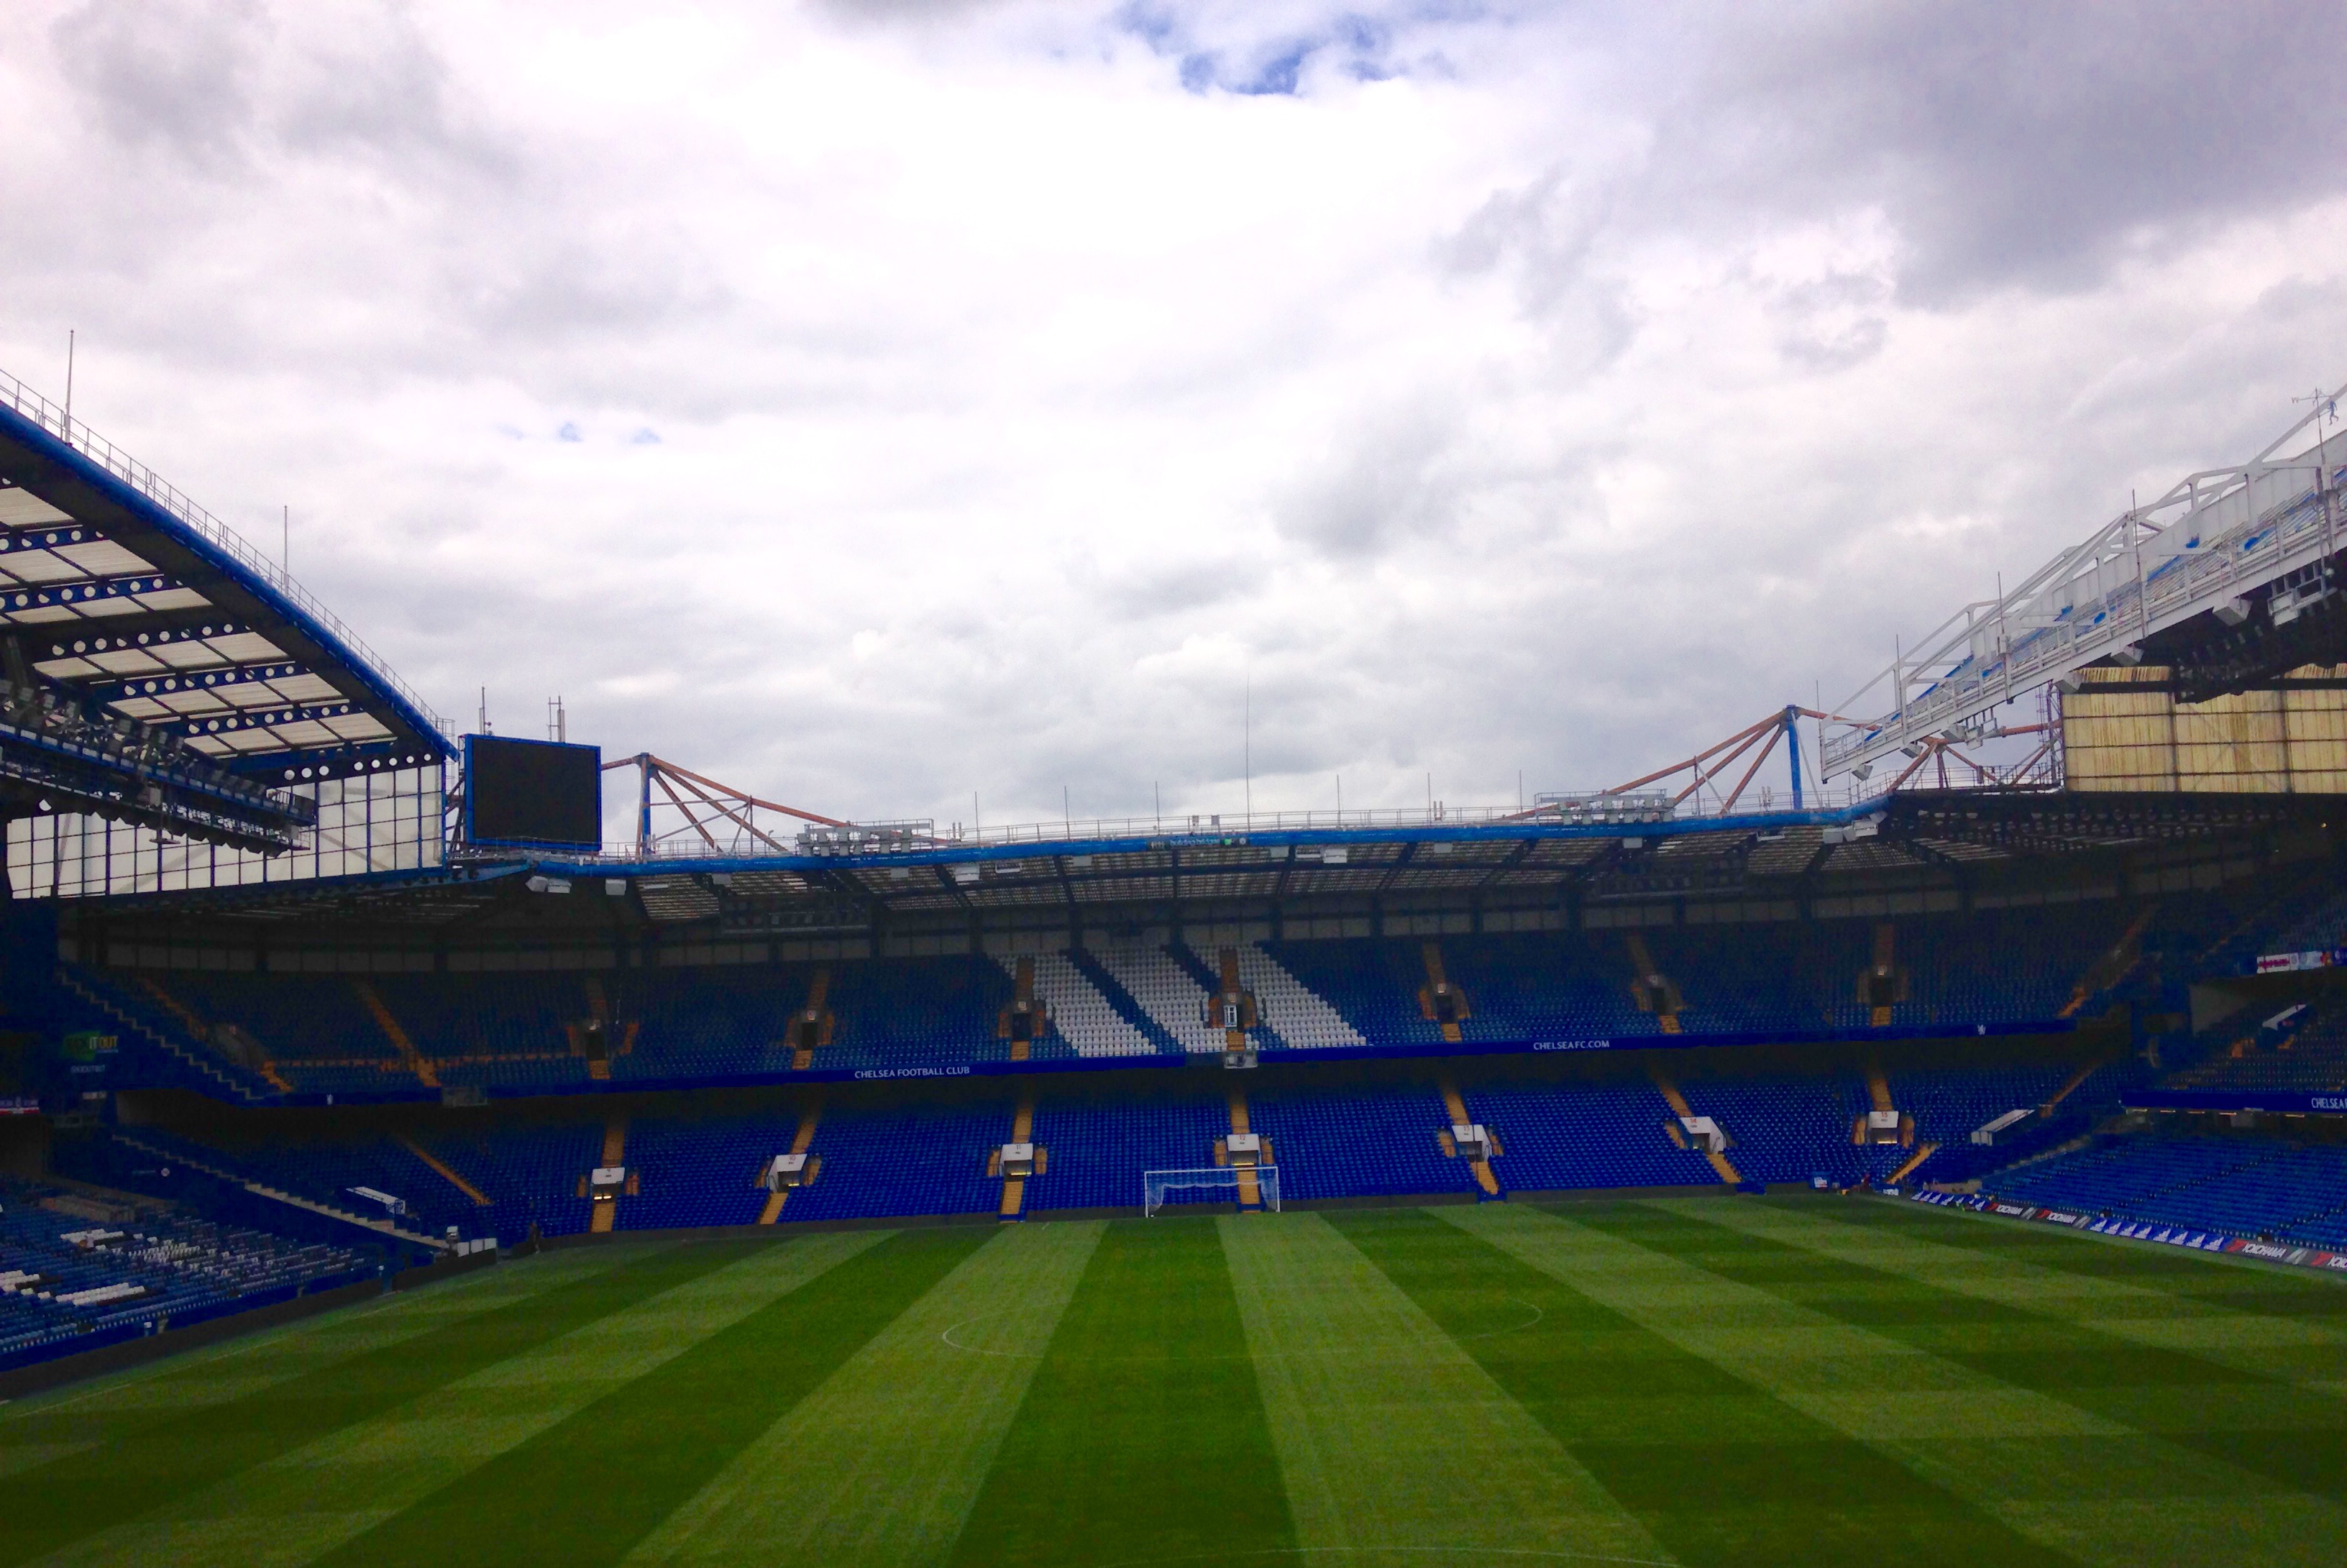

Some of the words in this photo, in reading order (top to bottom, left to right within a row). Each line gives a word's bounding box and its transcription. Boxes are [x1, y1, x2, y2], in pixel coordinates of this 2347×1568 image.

[1533, 1040, 1610, 1050] CHELSEAFC.COM
[854, 1069, 895, 1079] CHELSEA
[897, 1067, 945, 1077] FOOTBALL
[946, 1066, 970, 1076] CLUB
[2311, 1097, 2345, 1109] CHELSEA
[2242, 1242, 2287, 1258] YOKOHAMA
